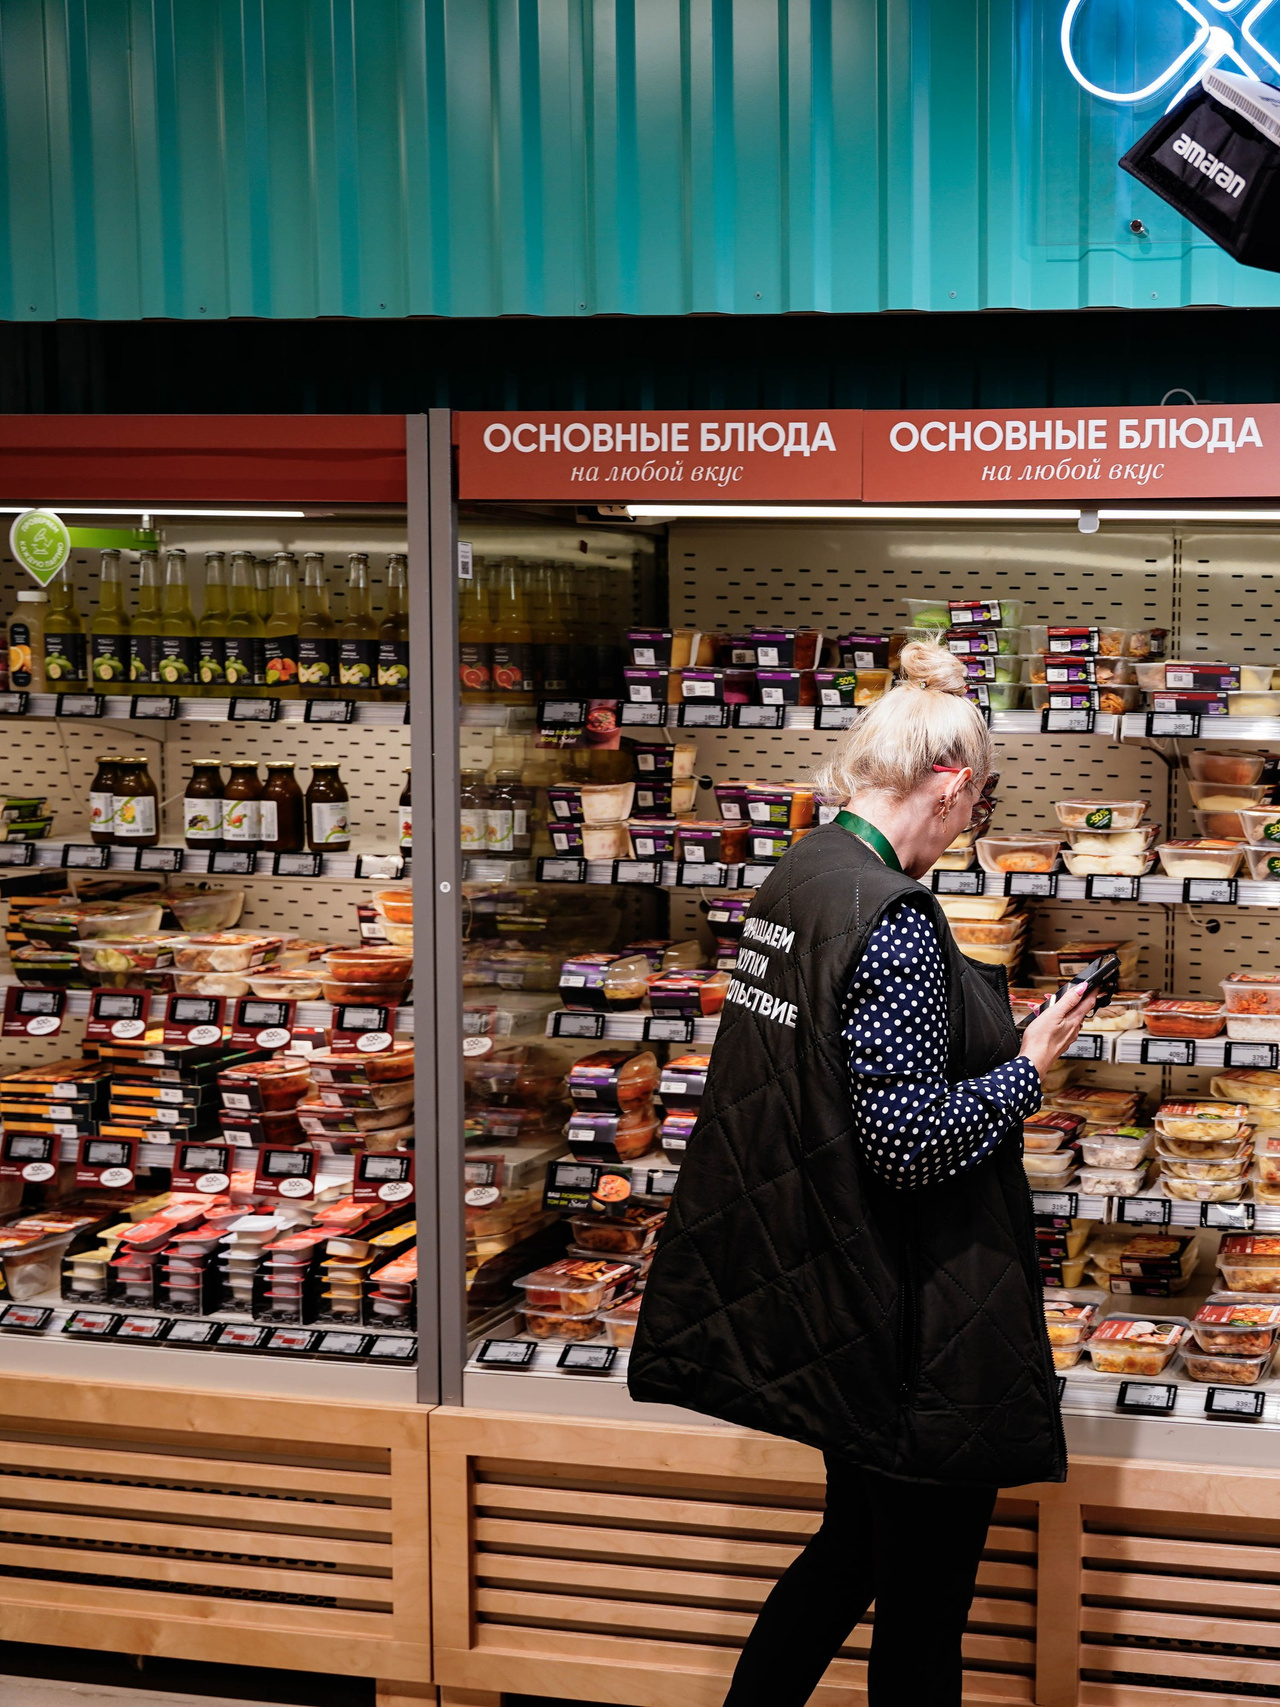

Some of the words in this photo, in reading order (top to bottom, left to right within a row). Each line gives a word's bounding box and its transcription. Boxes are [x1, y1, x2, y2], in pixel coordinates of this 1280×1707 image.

[1172, 133, 1245, 199] amaran
[484, 423, 689, 453] ОСНОВНЫЕ
[701, 422, 837, 457] БЛЮДА
[889, 418, 1107, 451] ОСНОВНЫЕ
[1118, 415, 1263, 453] БЛЮДА
[571, 467, 599, 482] на
[605, 460, 684, 482] любой
[691, 466, 744, 487] вкус
[981, 465, 1012, 481] на
[1019, 457, 1102, 482] любой
[1107, 462, 1165, 487] вкус
[836, 675, 856, 686] -50%
[1089, 808, 1109, 824] -50%
